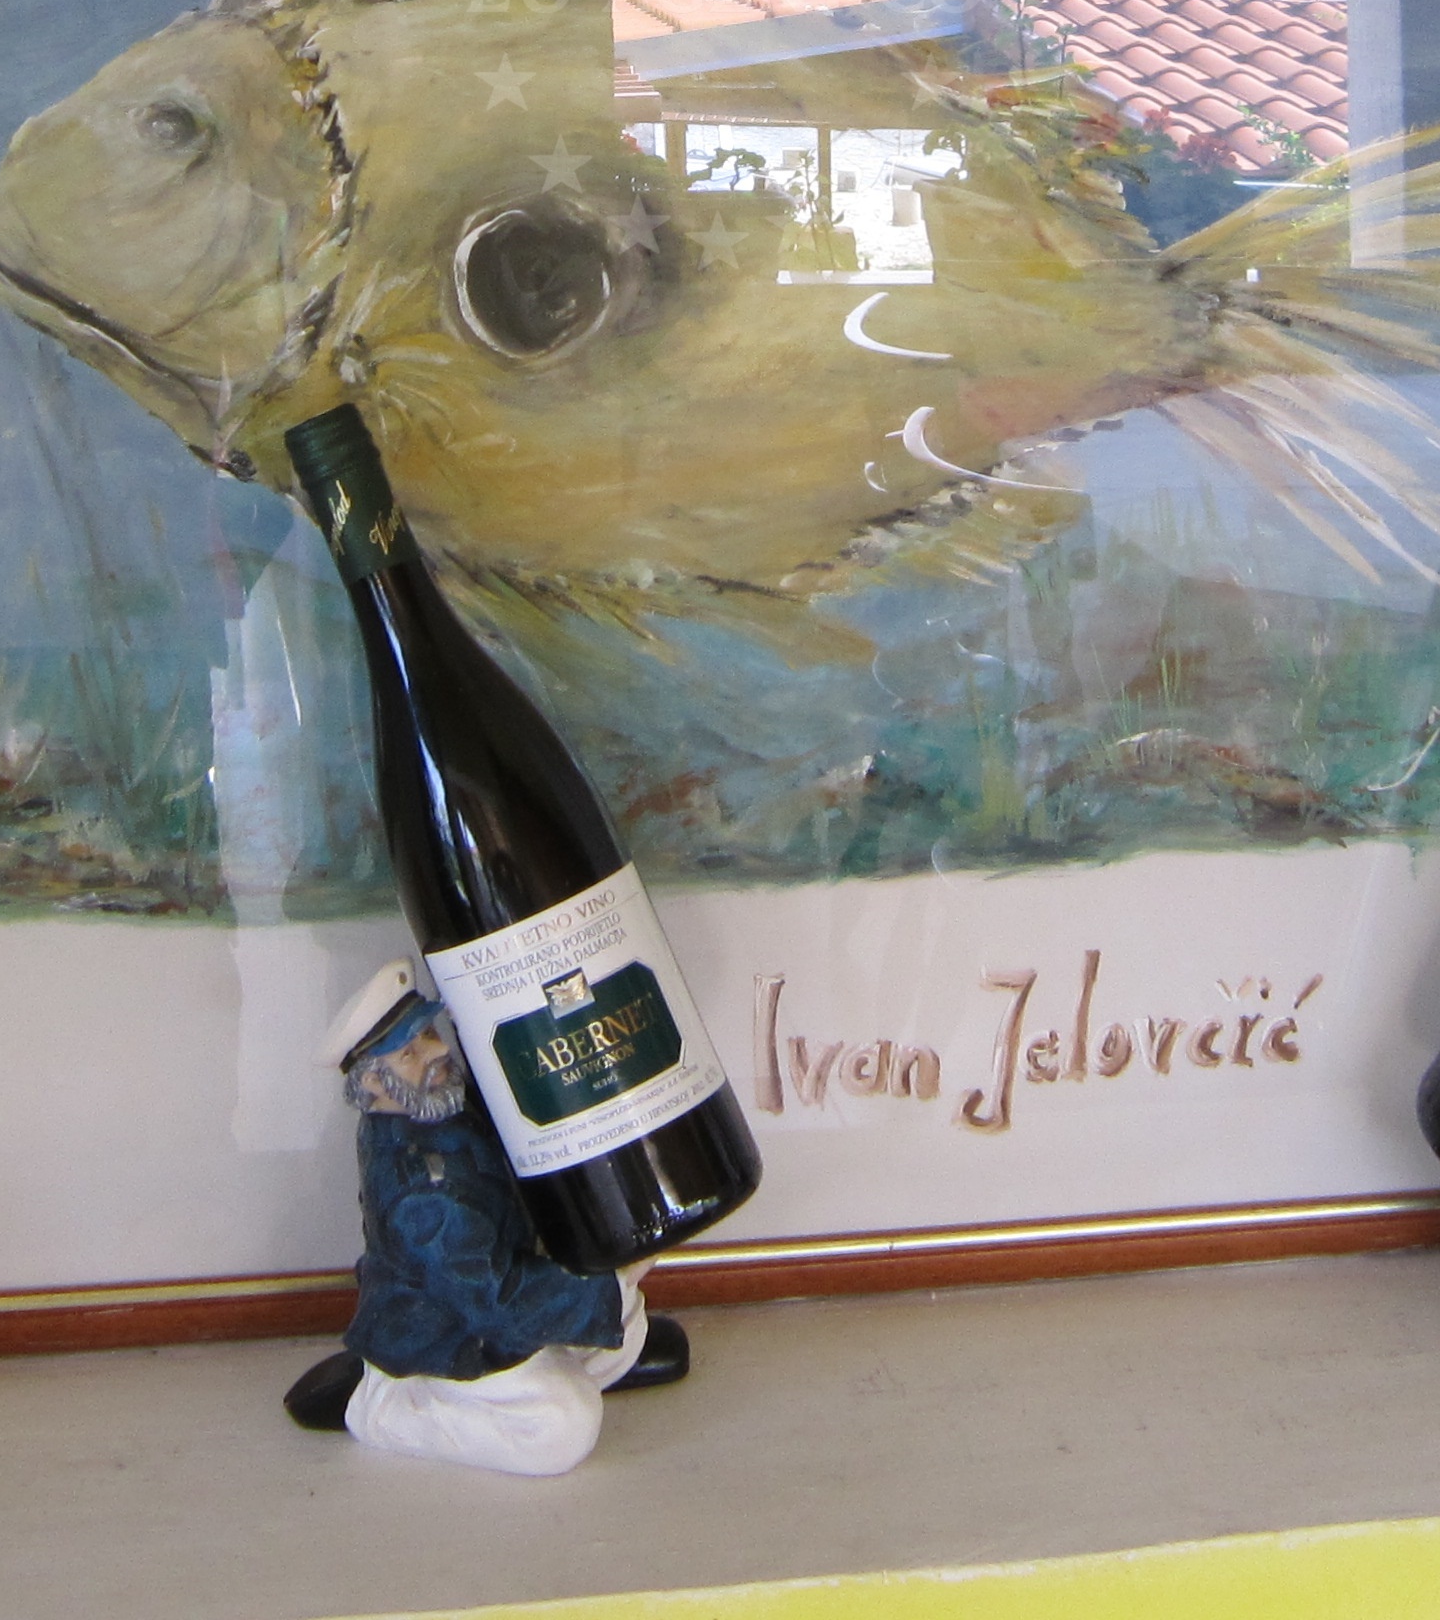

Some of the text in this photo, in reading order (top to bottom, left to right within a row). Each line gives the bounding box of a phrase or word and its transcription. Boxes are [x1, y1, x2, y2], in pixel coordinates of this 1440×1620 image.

[574, 887, 616, 918] VINO
[474, 911, 621, 987] KONTROLIRANO PODRIJETLO
[480, 974, 527, 1001] SREDNJA
[534, 954, 572, 983] JUŽNA
[572, 926, 627, 962] DALMACIJA
[519, 991, 656, 1081] ABERNET
[561, 1044, 635, 1086] SAUVIGNON
[753, 971, 942, 1114] Ivan
[576, 1118, 640, 1152] PROIZVEDENO
